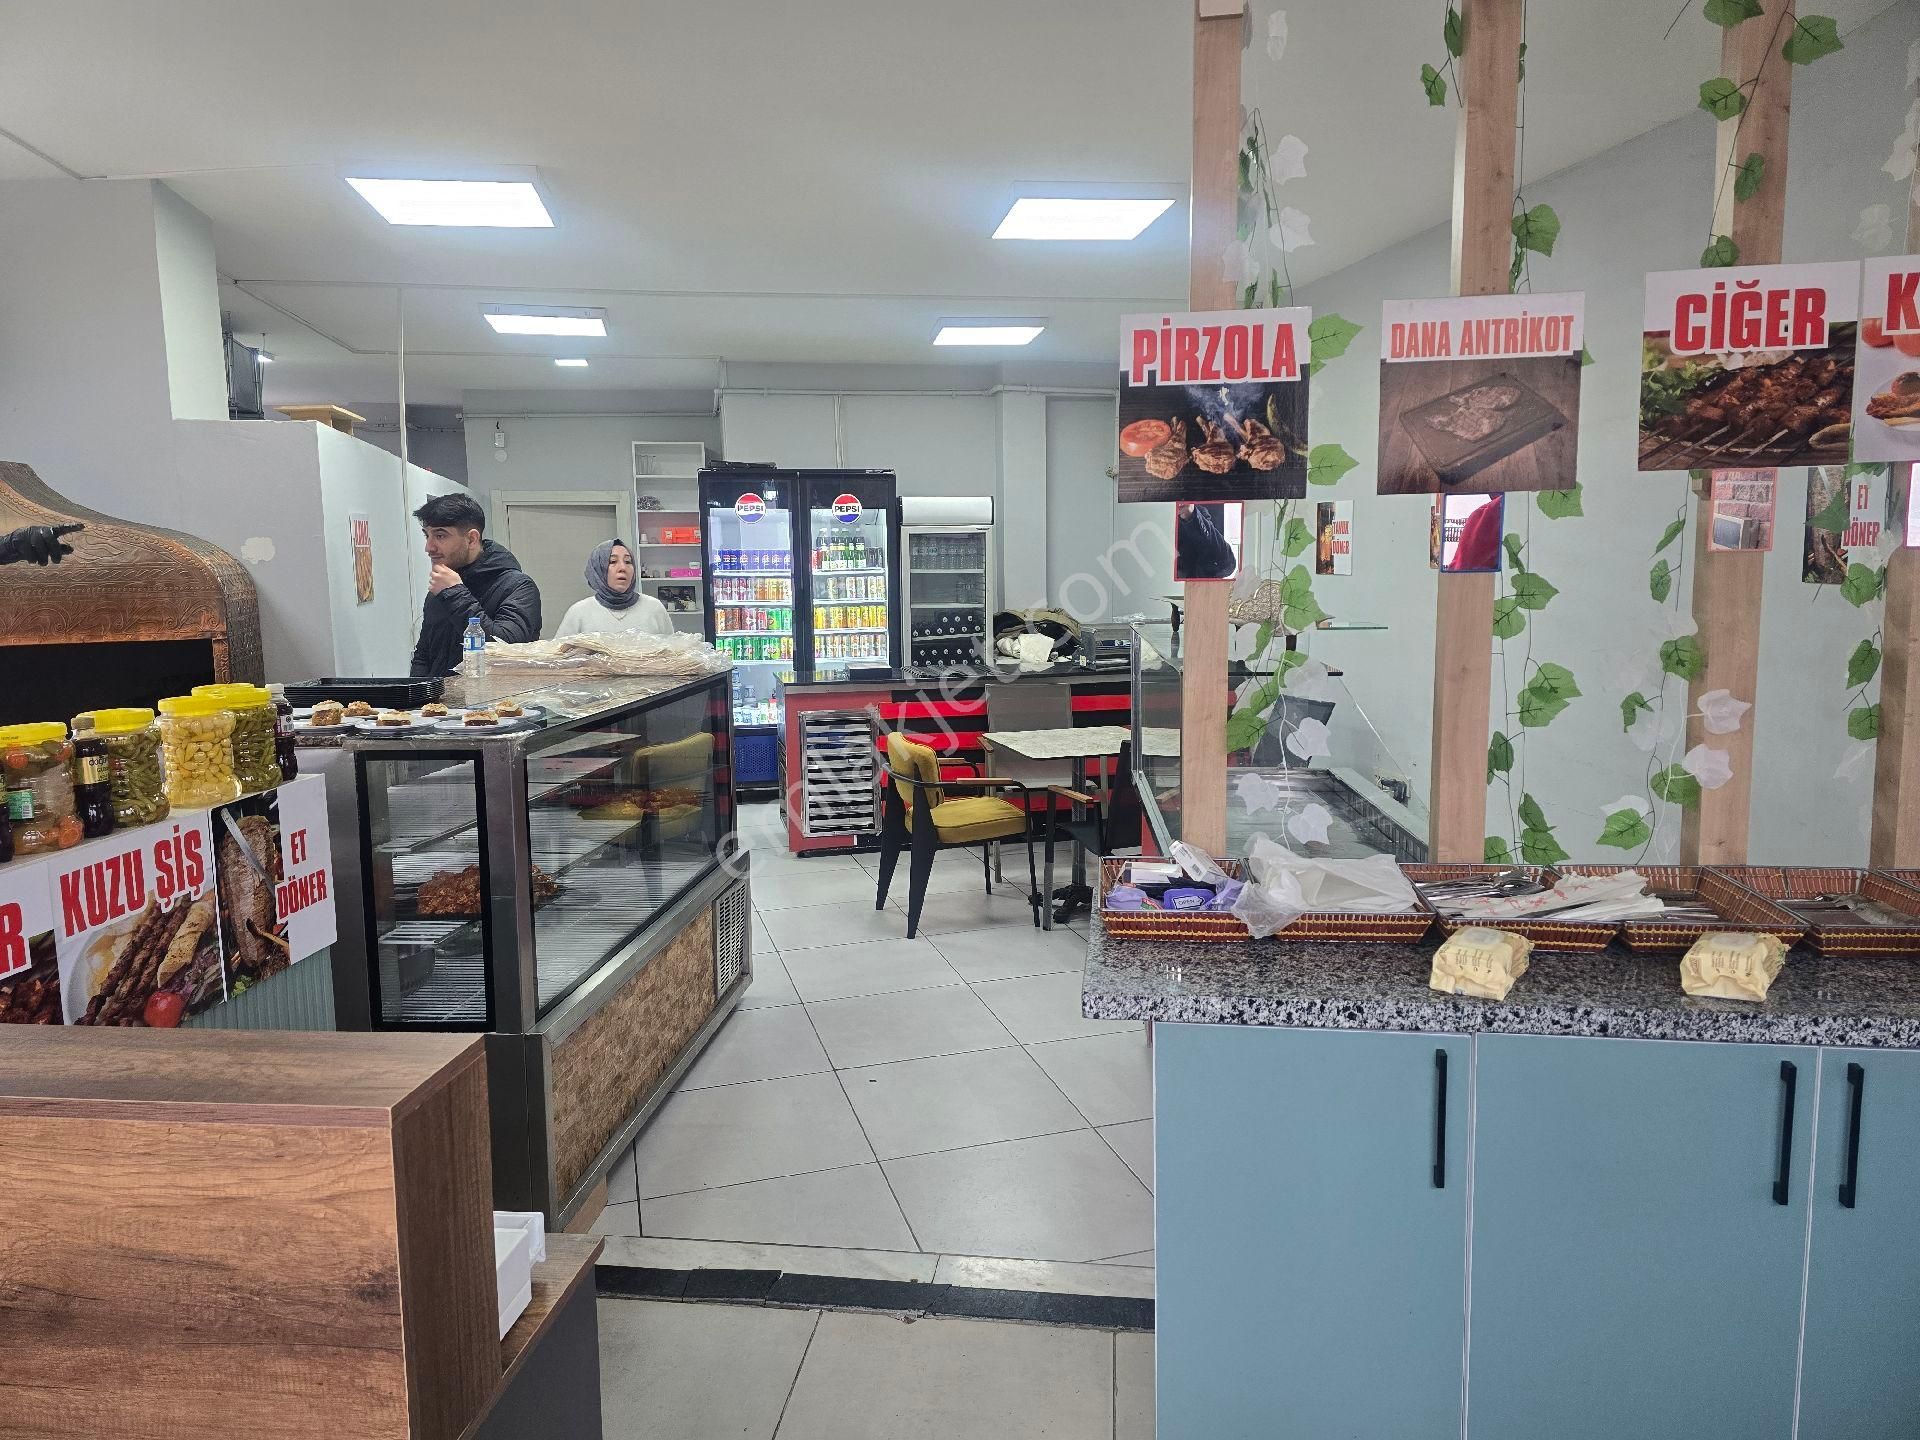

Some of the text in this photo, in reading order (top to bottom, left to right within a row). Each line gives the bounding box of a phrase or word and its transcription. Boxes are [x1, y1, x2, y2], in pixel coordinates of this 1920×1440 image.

[1390, 311, 1575, 358] DANA ANTRİKOT
[1674, 280, 1826, 352] CİĞER
[1132, 317, 1297, 383] PİRZOLA
[737, 504, 765, 513] PEPSI
[834, 505, 860, 513] PEPSI
[1857, 485, 1869, 510] ET
[1842, 516, 1880, 547] DÖNER
[290, 828, 307, 866] ET
[59, 824, 205, 938] KUZU ŞİŞ
[277, 868, 328, 919] DÖNER
